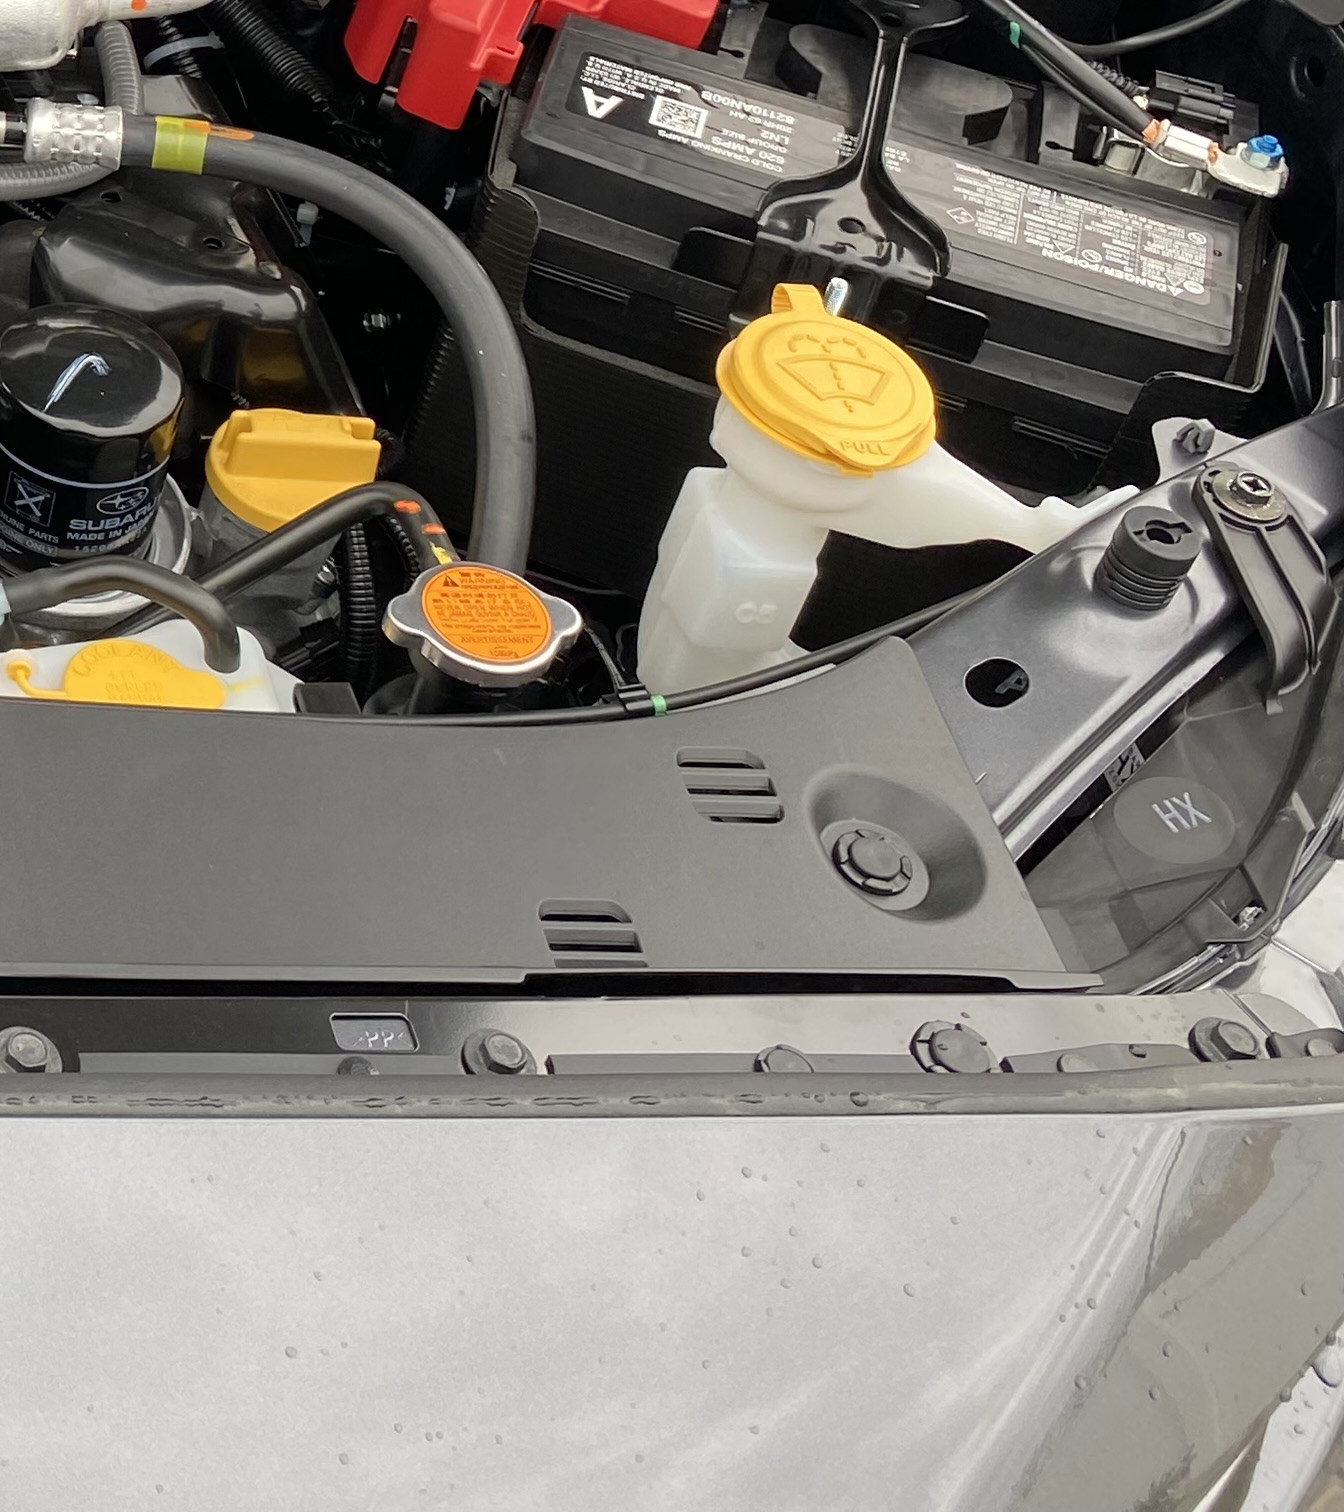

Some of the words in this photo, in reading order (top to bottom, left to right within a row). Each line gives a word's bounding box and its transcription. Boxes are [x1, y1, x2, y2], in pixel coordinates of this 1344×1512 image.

[581, 86, 624, 119] A
[712, 135, 757, 156] AMPS
[760, 129, 790, 145] LN2
[691, 139, 750, 164] CRANKING
[751, 157, 784, 174] COLD
[840, 439, 892, 457] PULL
[69, 497, 157, 531] SUBARU
[28, 527, 59, 544] PARTS
[66, 532, 105, 541] MADE
[108, 528, 123, 539] IN
[1151, 791, 1212, 833] HX
